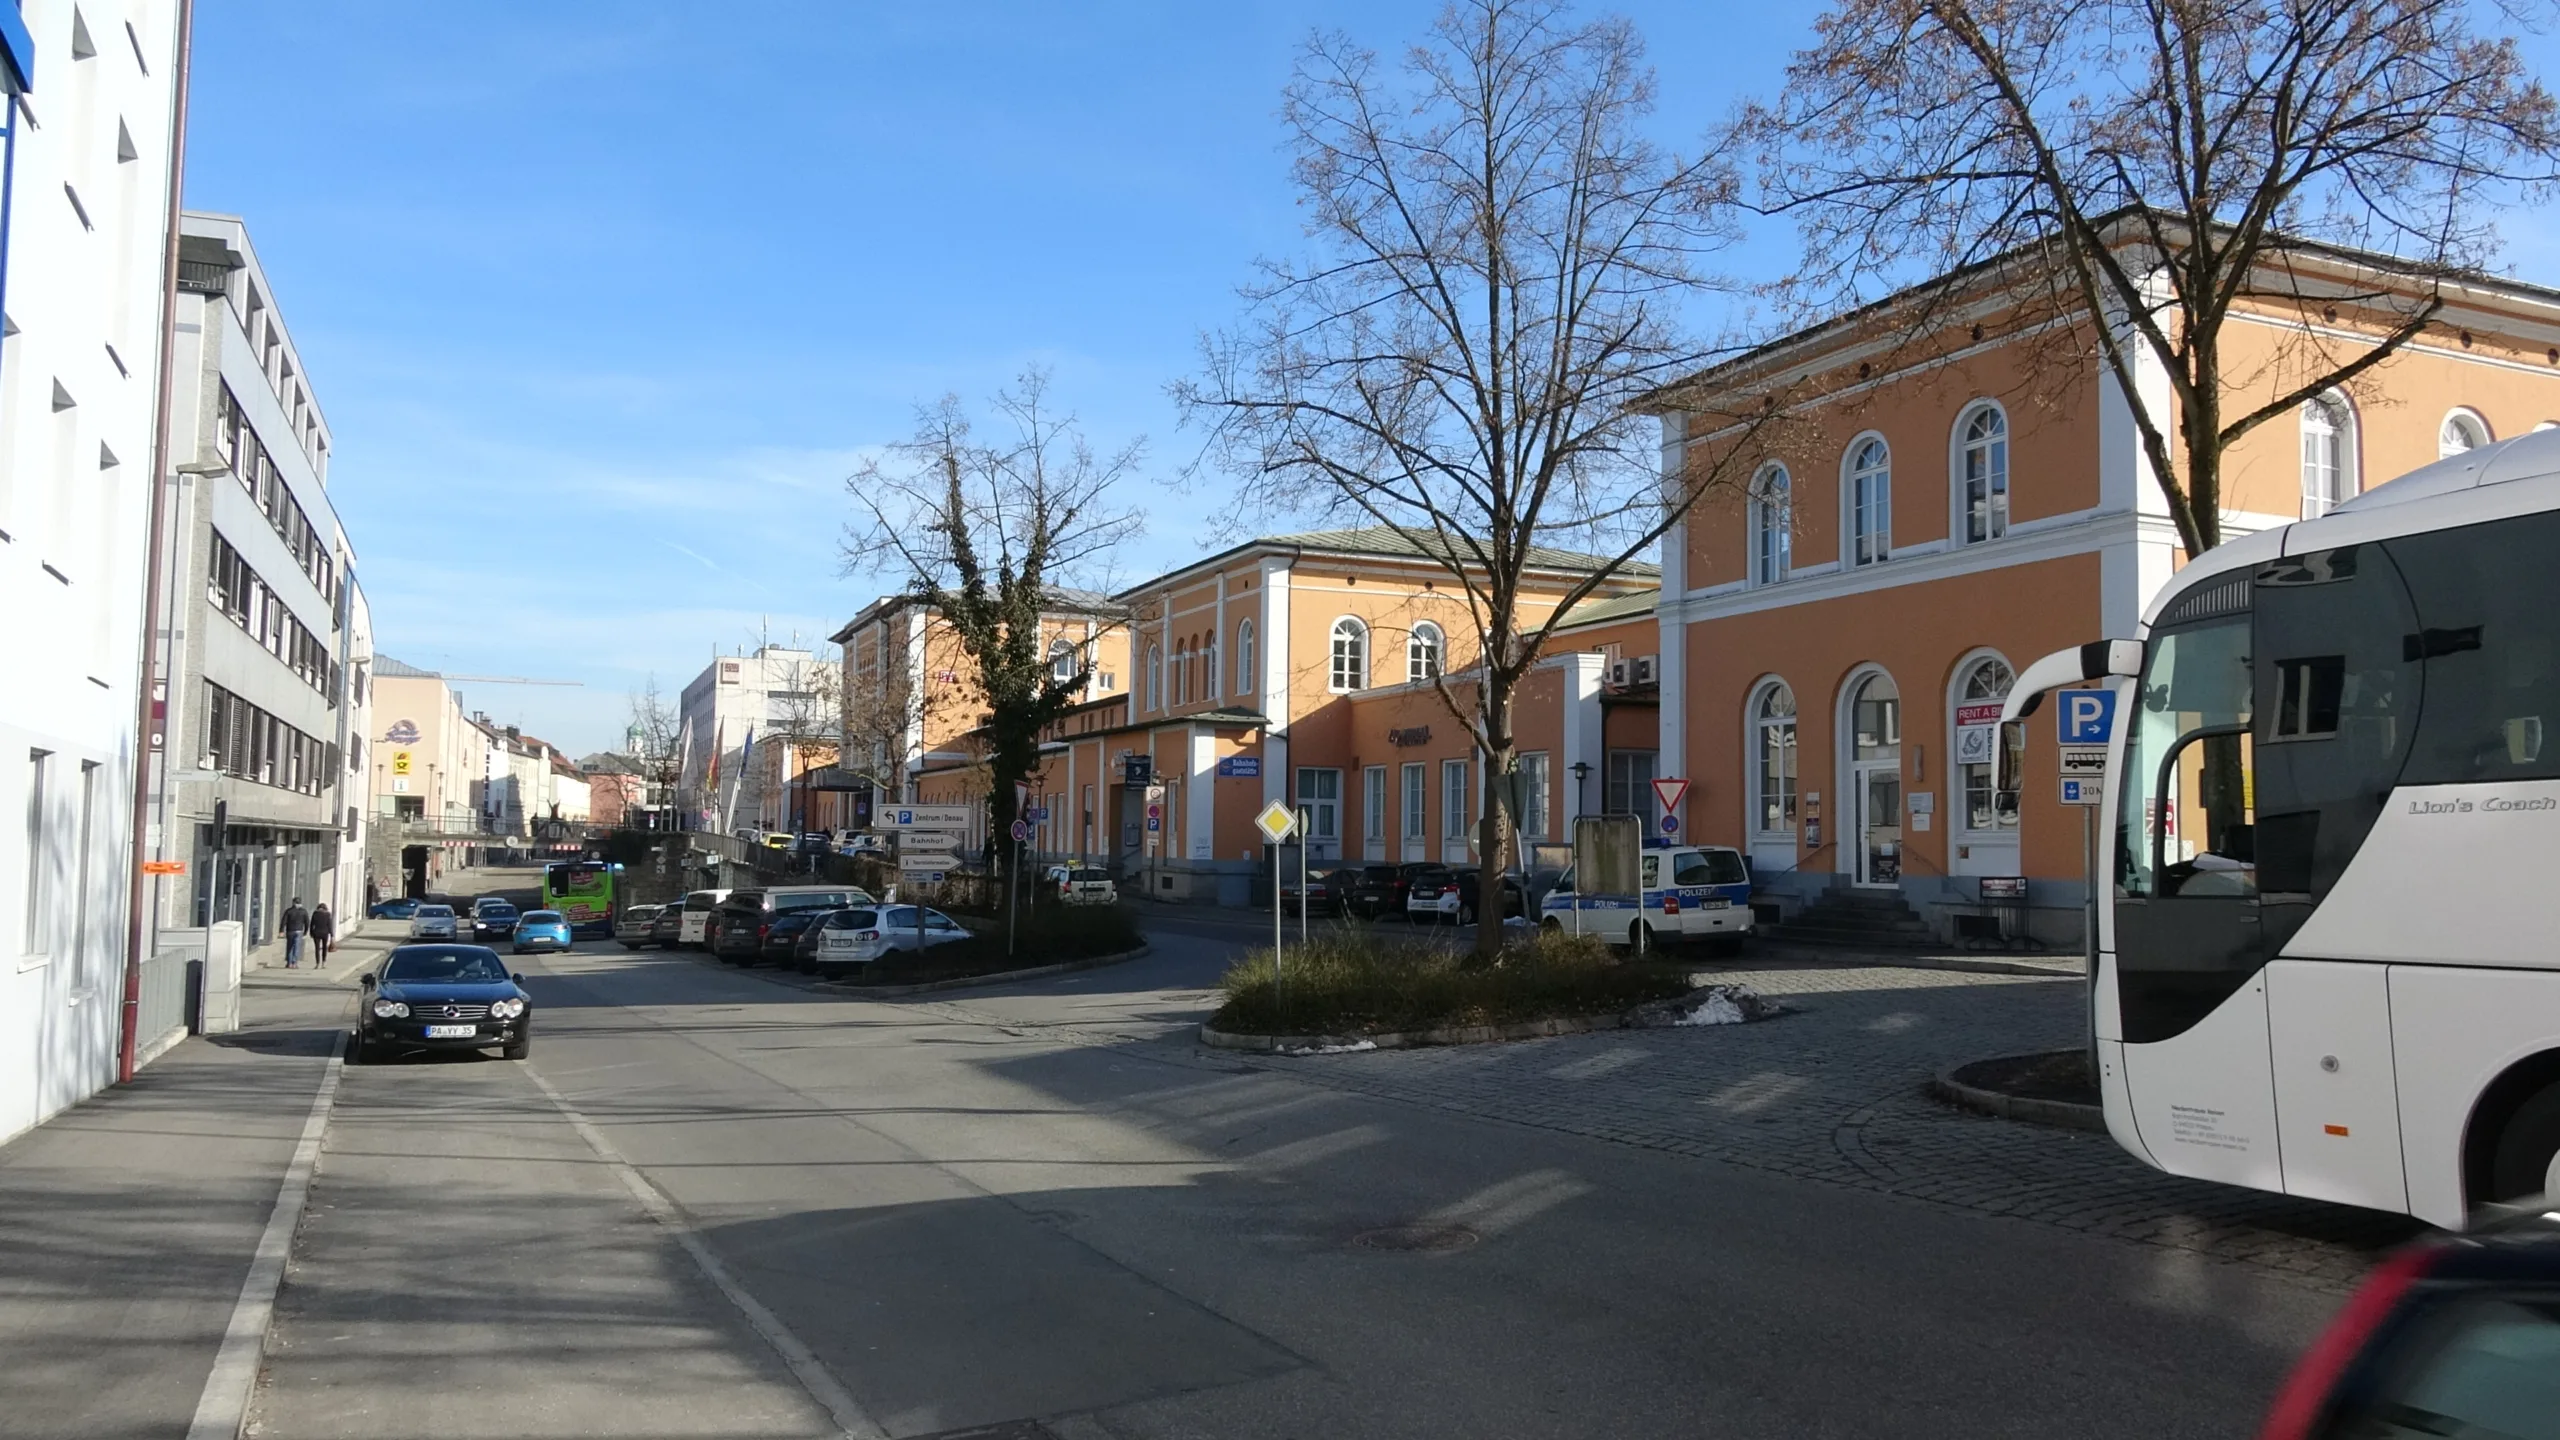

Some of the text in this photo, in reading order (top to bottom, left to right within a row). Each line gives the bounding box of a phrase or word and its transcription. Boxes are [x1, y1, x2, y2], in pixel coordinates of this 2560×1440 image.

[1958, 707, 1981, 719] RENT
[1982, 707, 1990, 717] A
[2071, 696, 2103, 737] P
[2408, 797, 2557, 815] Lion's Coach
[901, 812, 910, 822] P
[915, 814, 940, 822] Zentrum
[944, 814, 964, 822] Donau
[1150, 819, 1157, 830] P
[1678, 887, 1711, 897] POLIZEI
[431, 1027, 442, 1035] PA
[447, 1027, 458, 1035] YY
